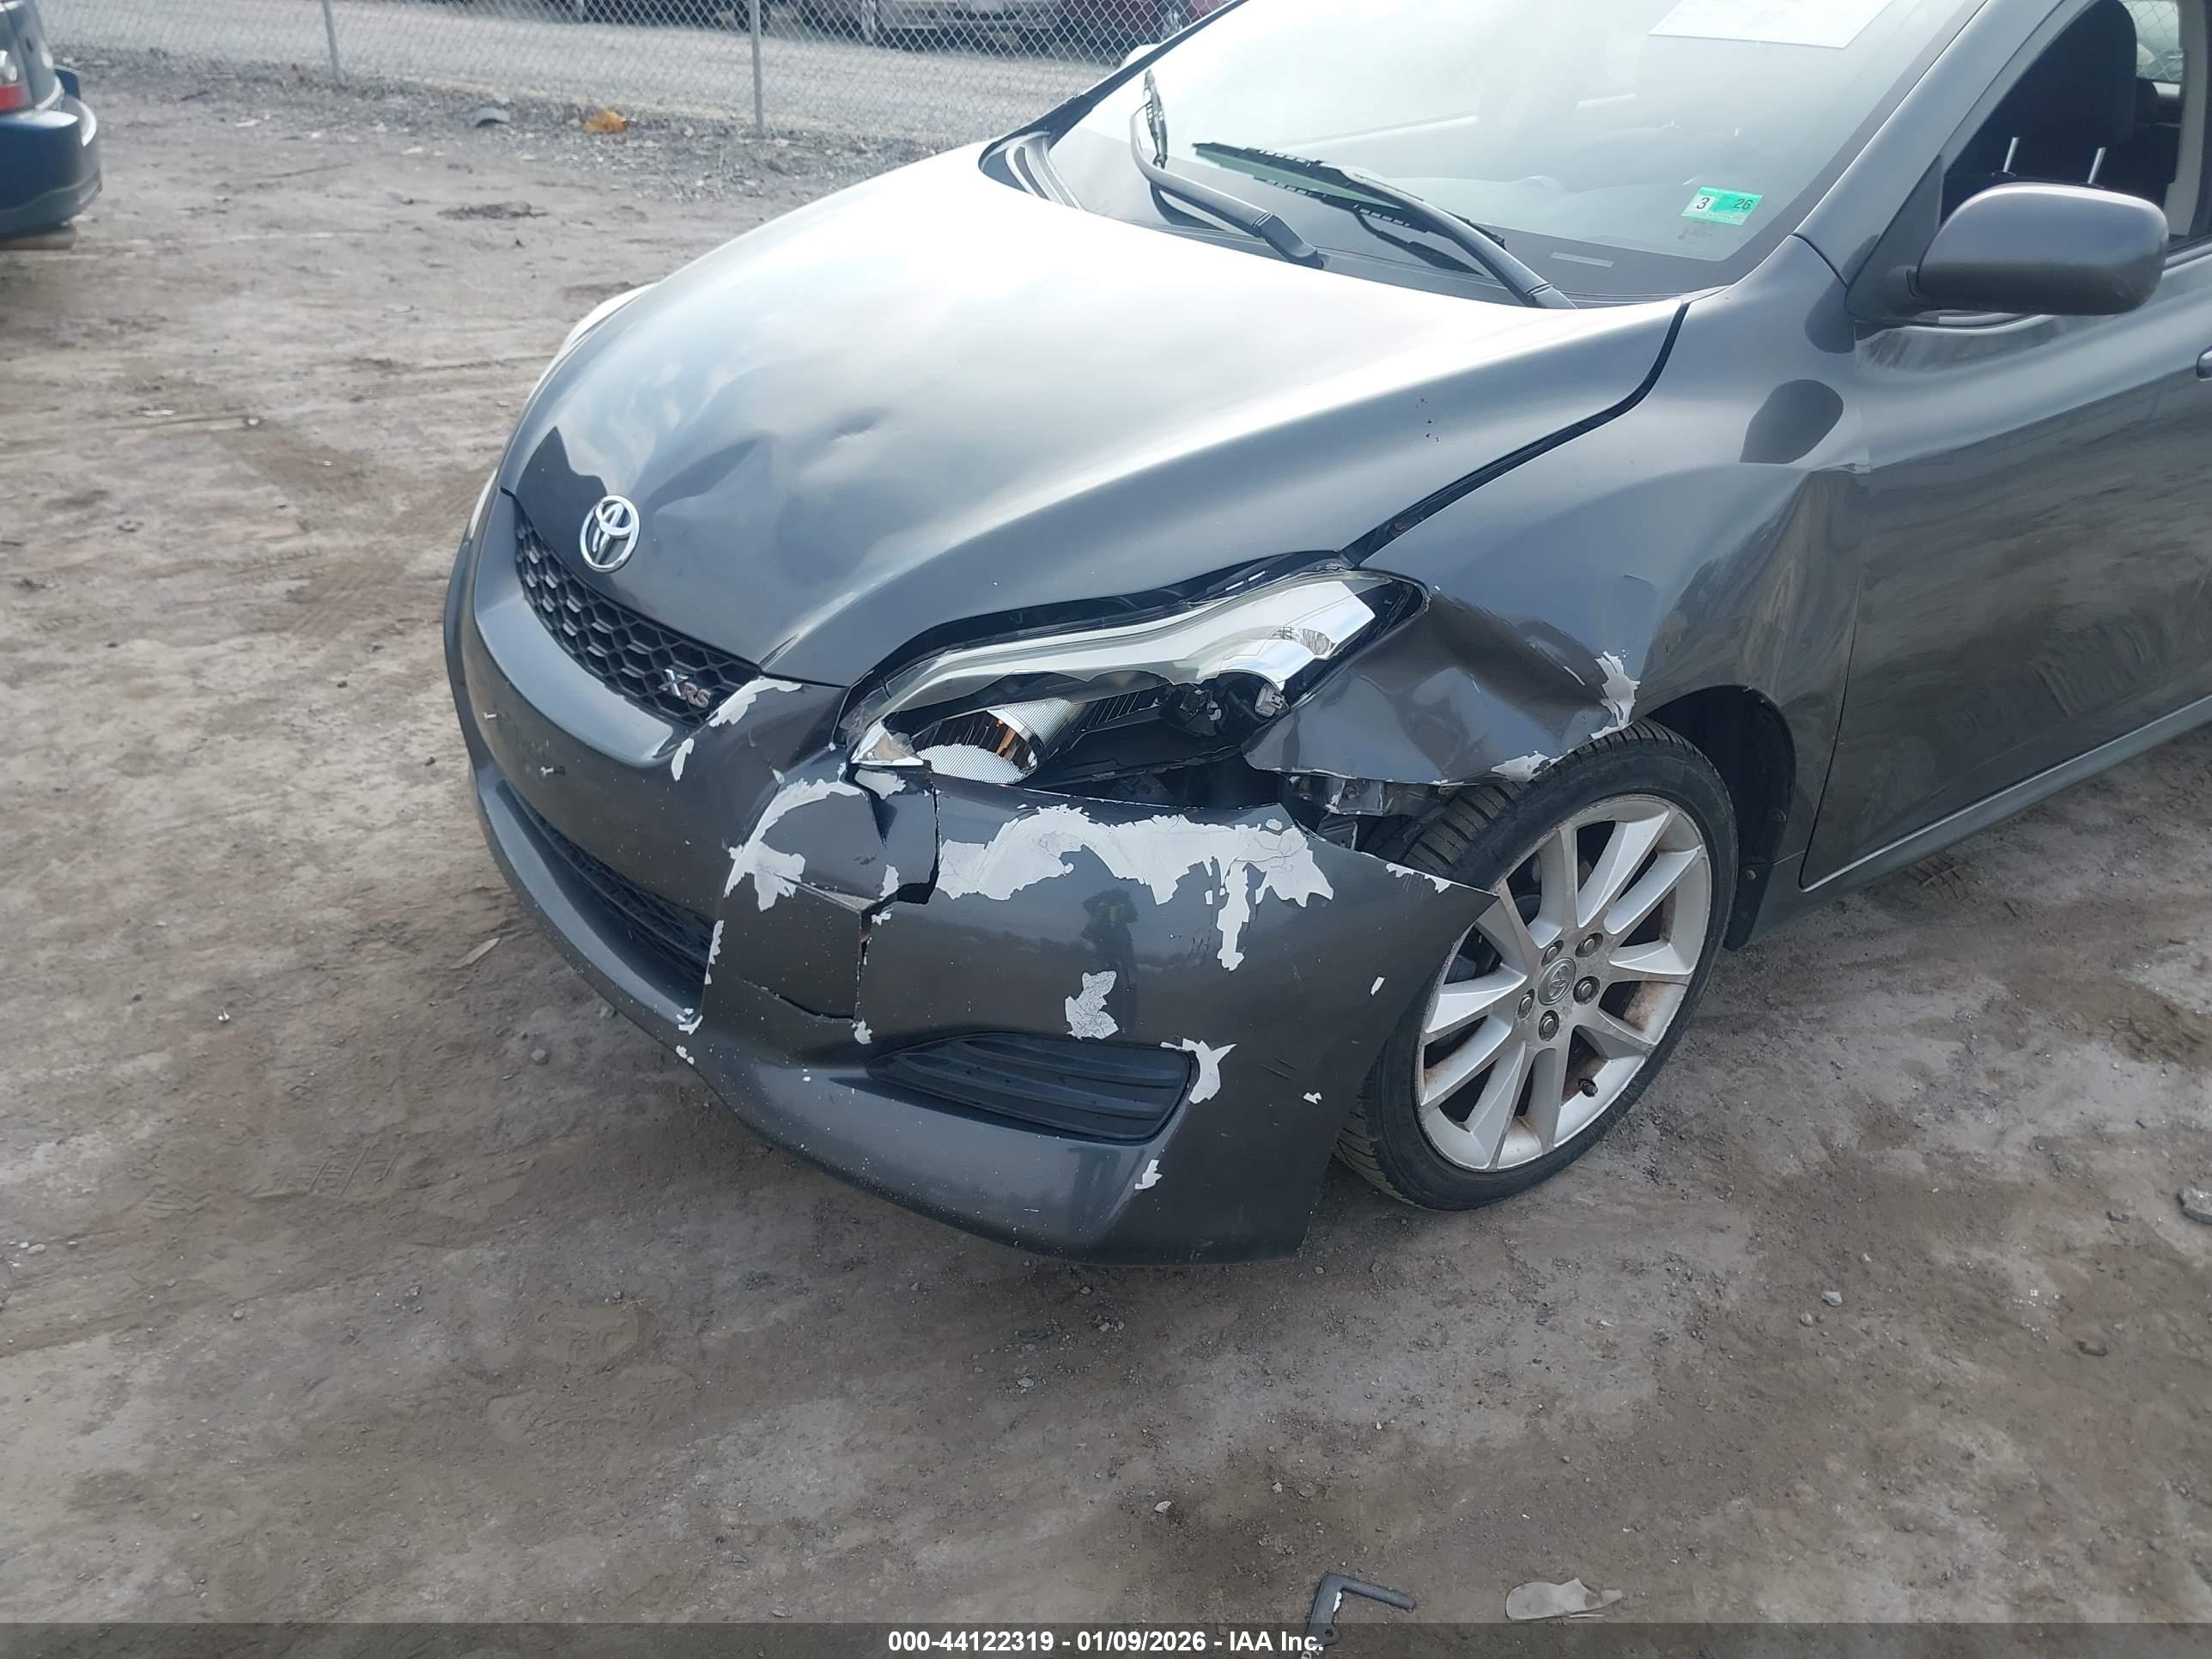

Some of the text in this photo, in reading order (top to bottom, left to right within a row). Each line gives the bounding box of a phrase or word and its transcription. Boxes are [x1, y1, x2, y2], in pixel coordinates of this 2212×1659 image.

[1697, 197, 1753, 210] 3 26
[658, 668, 711, 708] XRS
